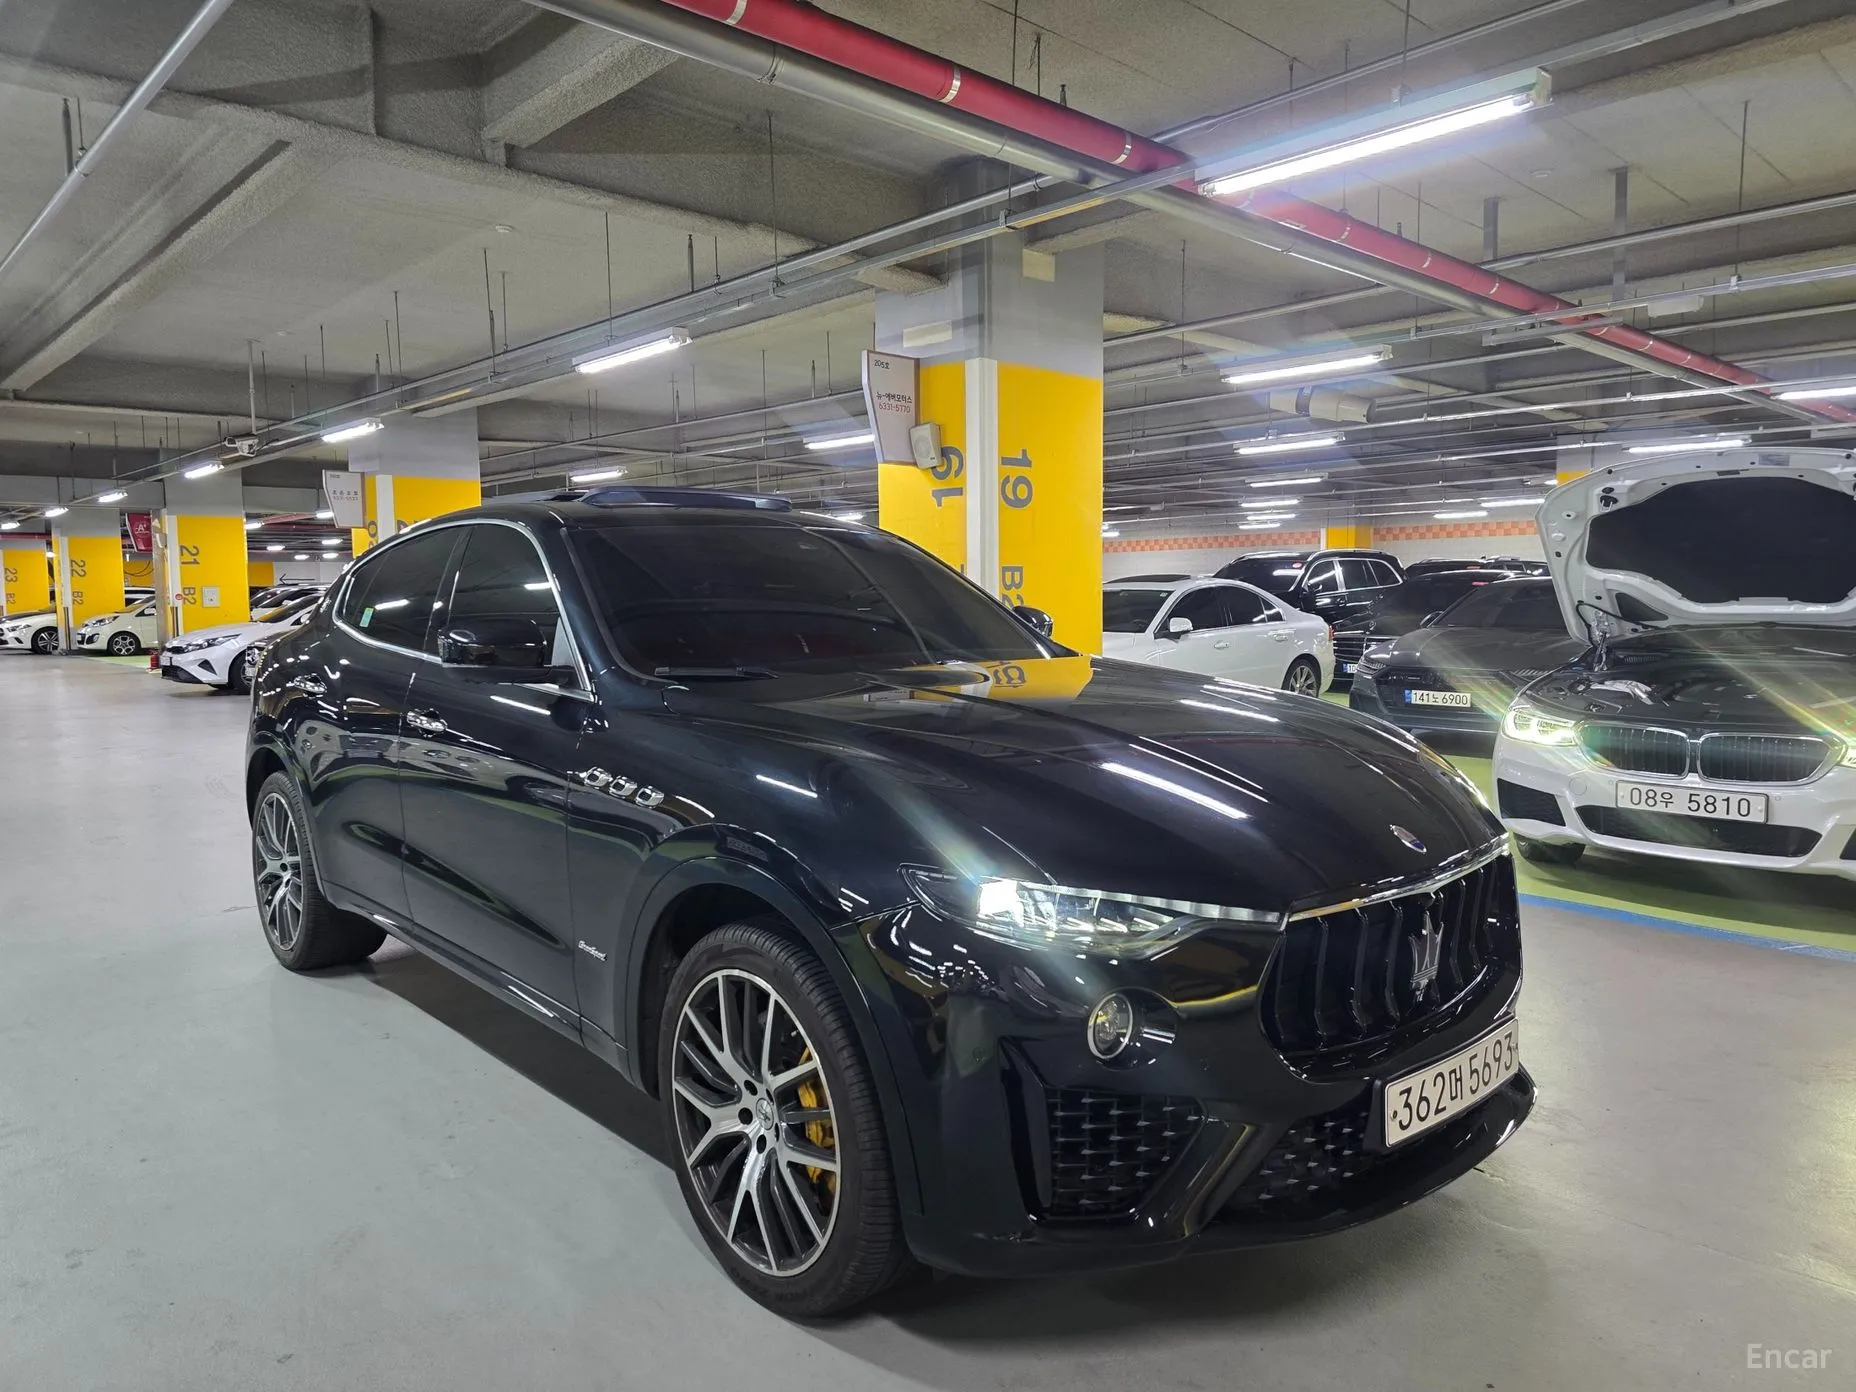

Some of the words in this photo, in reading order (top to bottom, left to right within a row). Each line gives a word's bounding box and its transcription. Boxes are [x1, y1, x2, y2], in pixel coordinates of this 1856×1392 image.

[1001, 448, 1033, 508] 19
[180, 544, 200, 566] 21
[5, 567, 18, 583] 23
[71, 560, 87, 578] 22
[72, 591, 84, 605] B2
[182, 587, 197, 605] B2
[1413, 691, 1439, 704] 141노
[1441, 693, 1468, 706] 6900
[1630, 787, 1674, 809] 08우
[1687, 793, 1751, 817] 5810
[1398, 1065, 1463, 1130] 362머
[1469, 1031, 1513, 1095] 5693
